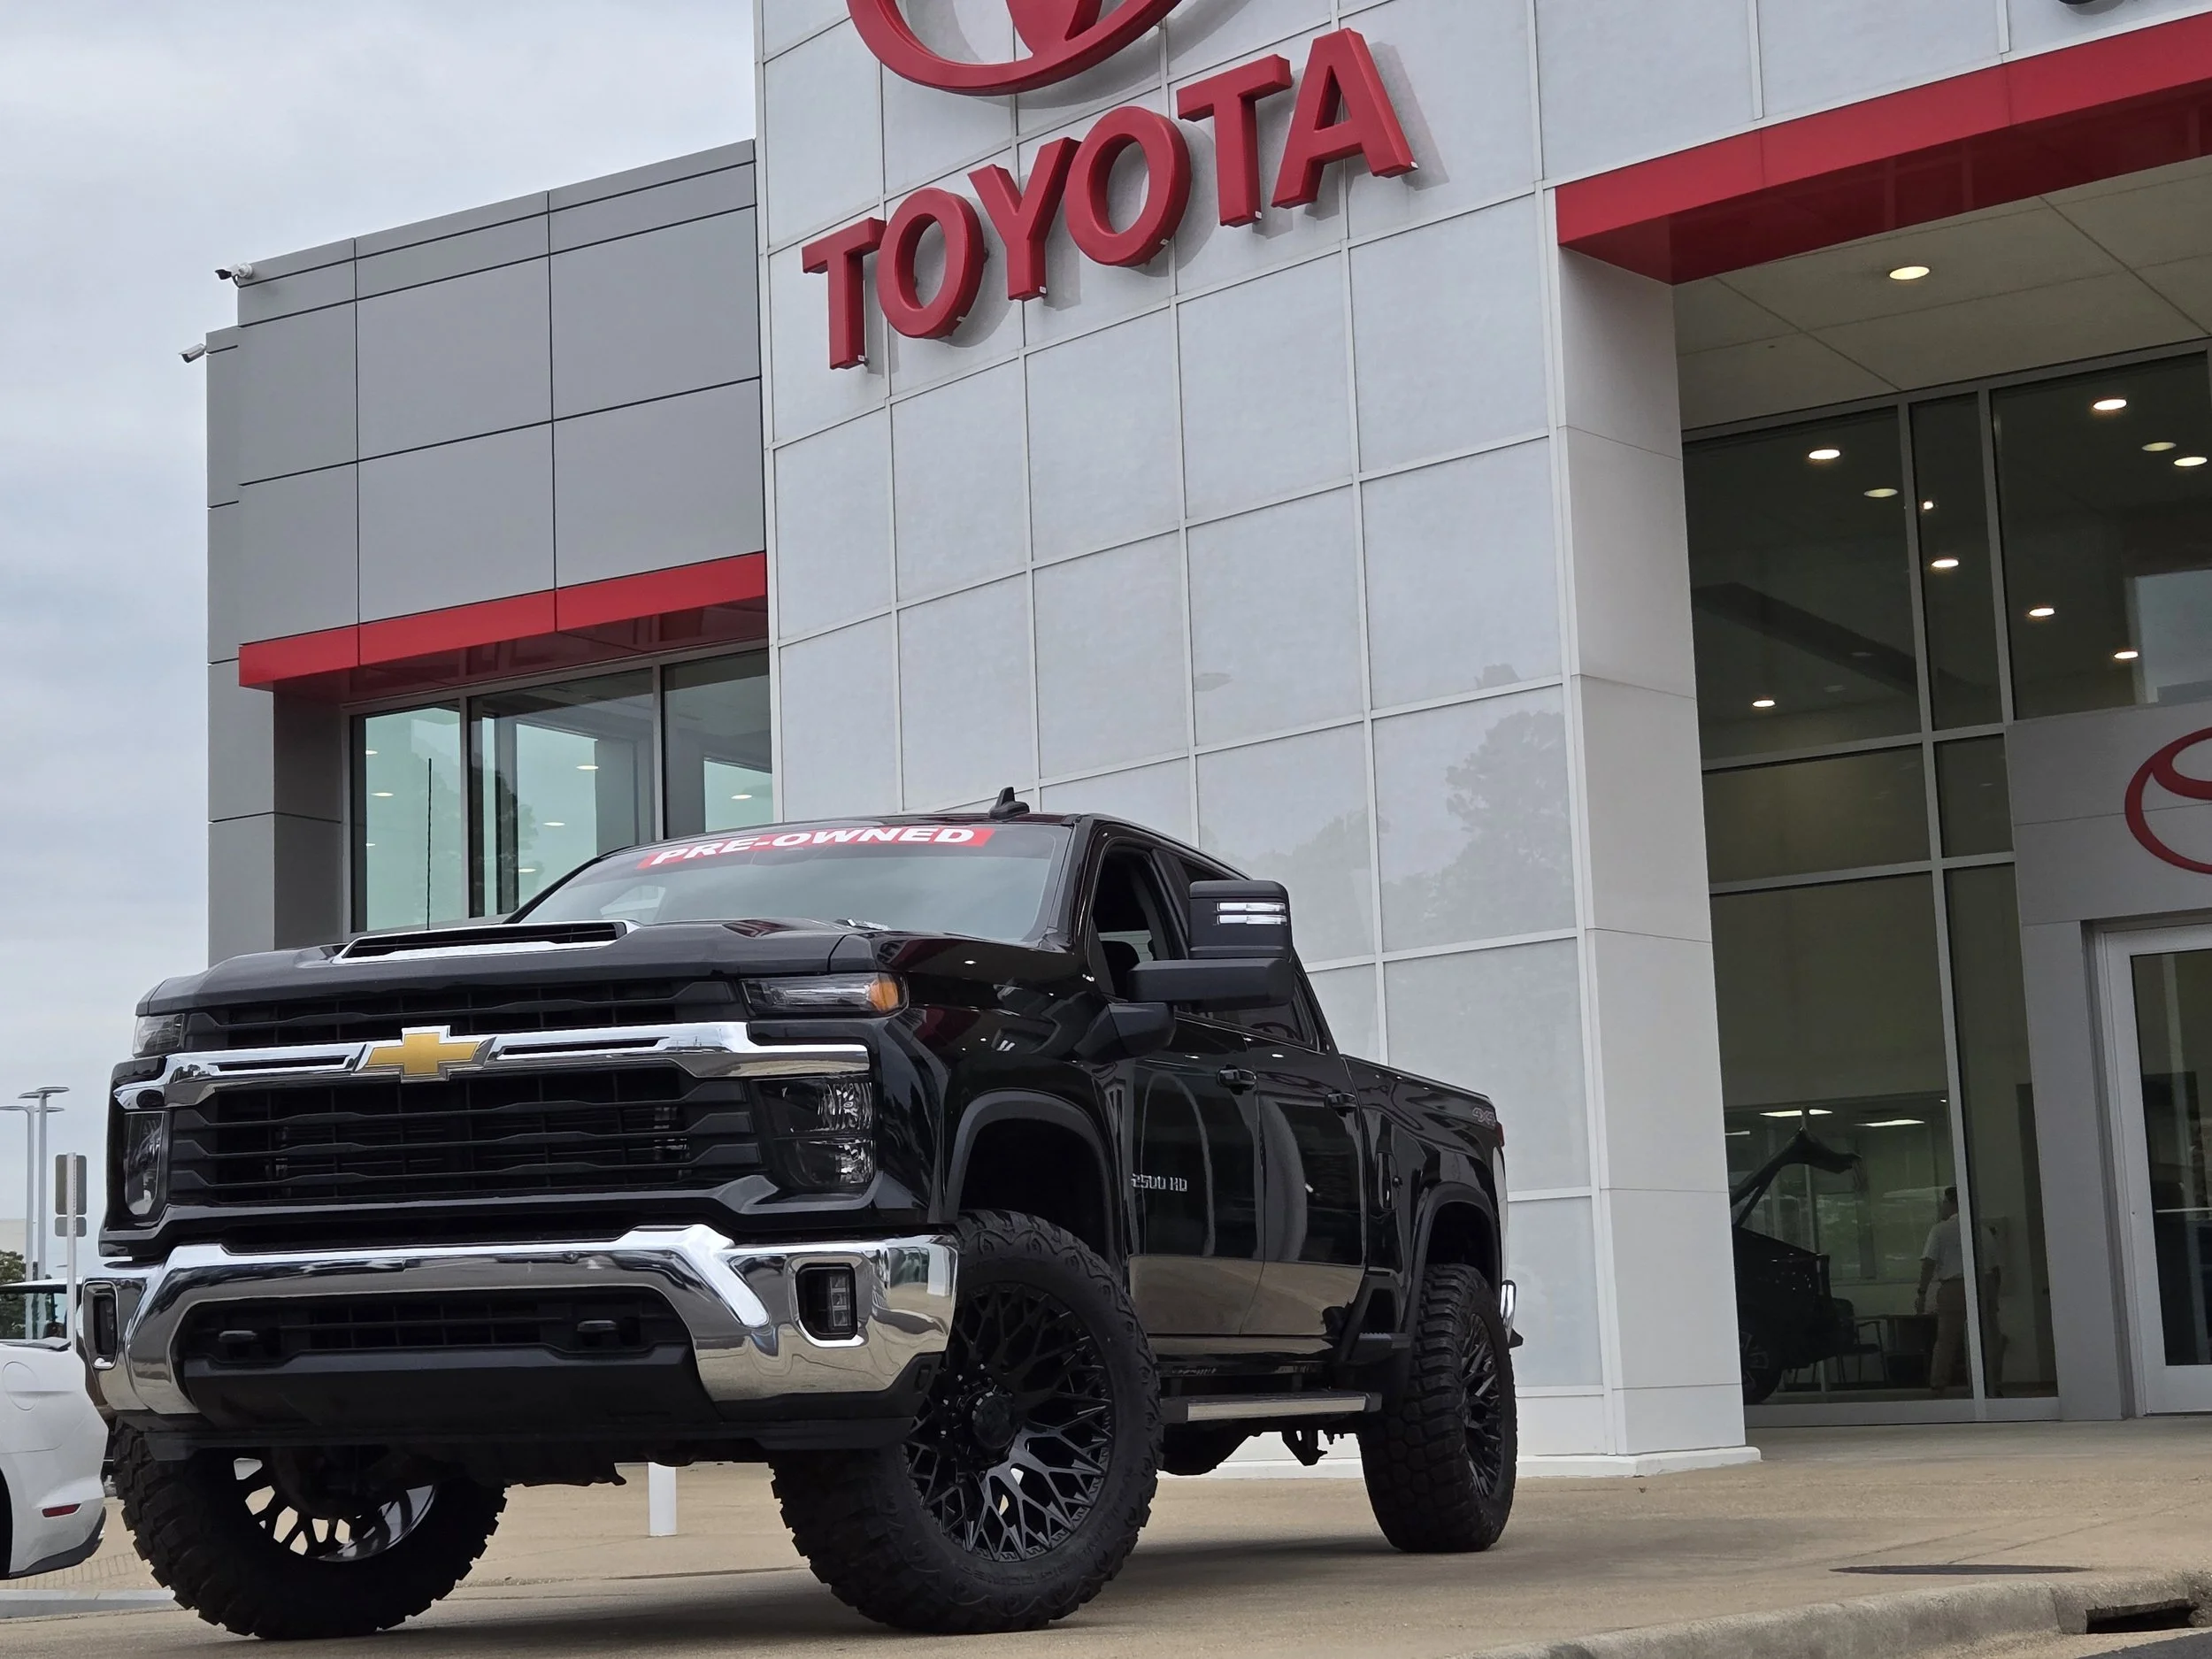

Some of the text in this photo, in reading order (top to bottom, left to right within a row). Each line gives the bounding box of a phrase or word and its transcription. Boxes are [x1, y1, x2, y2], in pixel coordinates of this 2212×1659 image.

[802, 27, 1417, 370] TOYOTA
[650, 826, 976, 865] PRE-OWNED
[1131, 1173, 1188, 1192] 2500 HD
